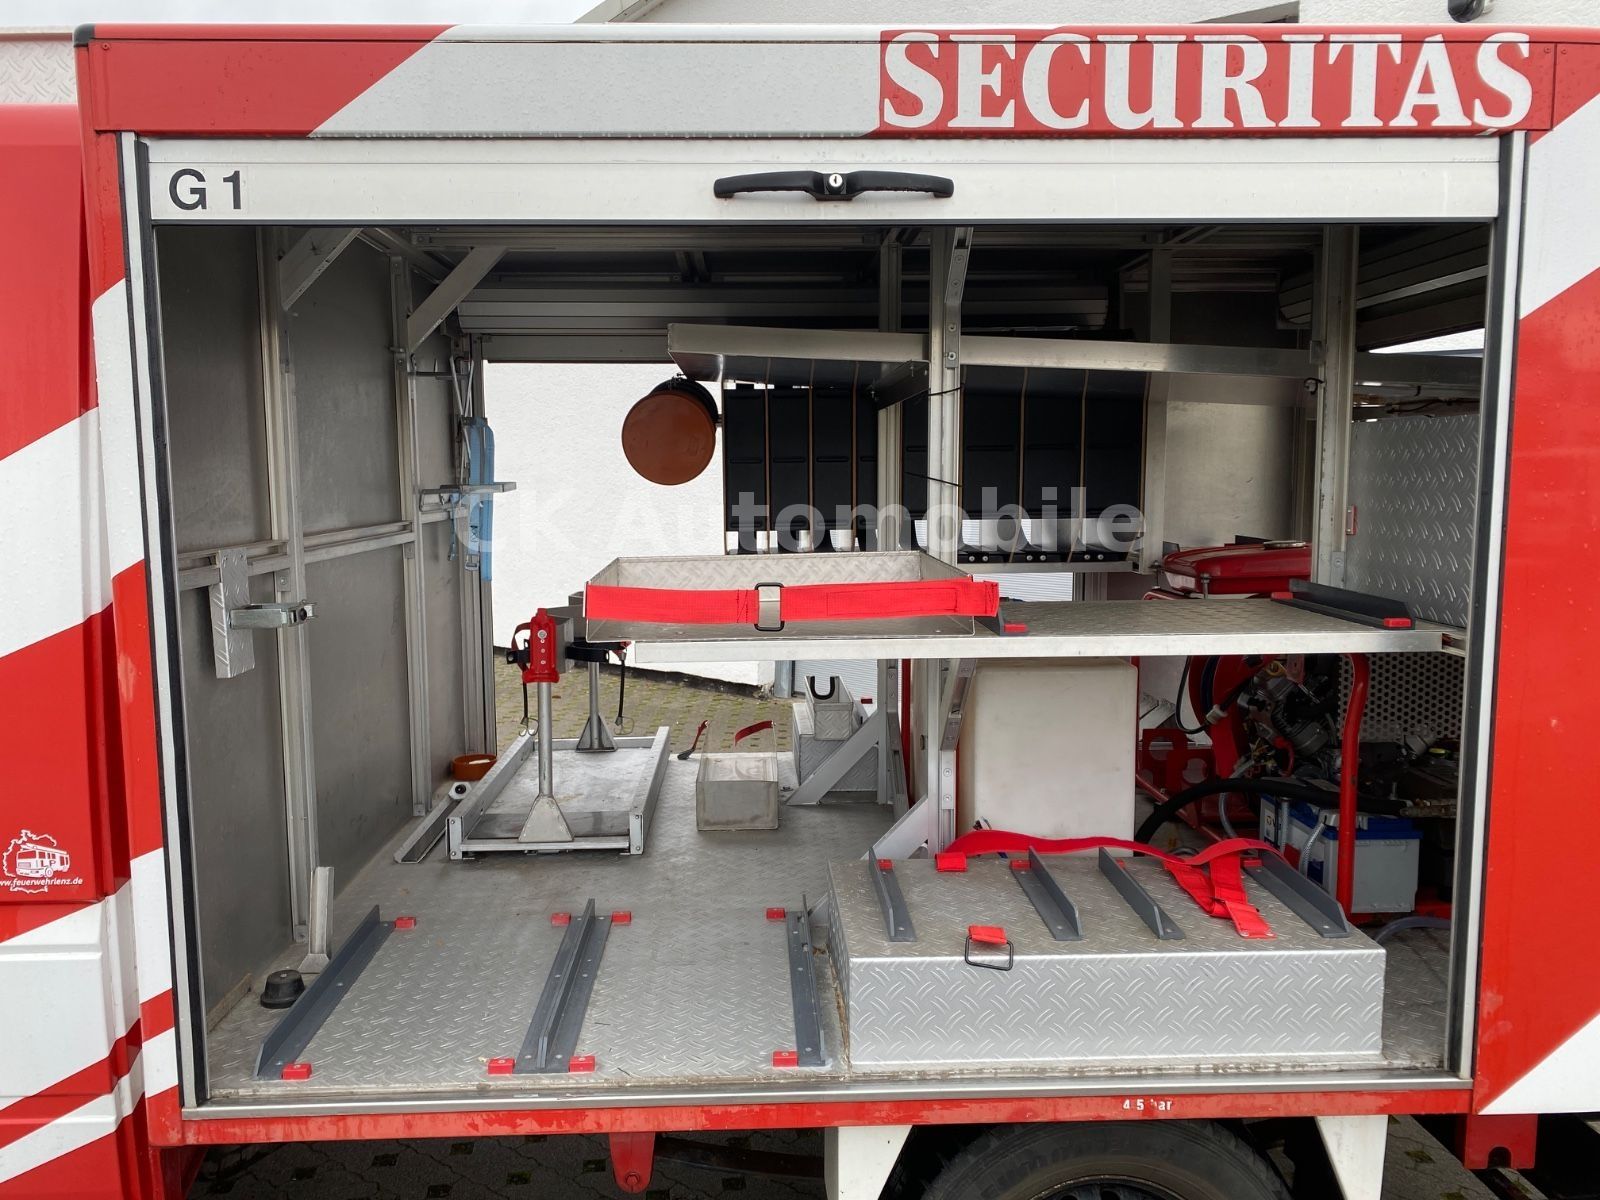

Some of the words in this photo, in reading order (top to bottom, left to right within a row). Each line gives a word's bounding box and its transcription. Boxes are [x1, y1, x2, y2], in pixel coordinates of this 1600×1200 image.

[883, 31, 1533, 130] SECURITAS
[168, 168, 208, 211] G
[222, 170, 242, 210] 1
